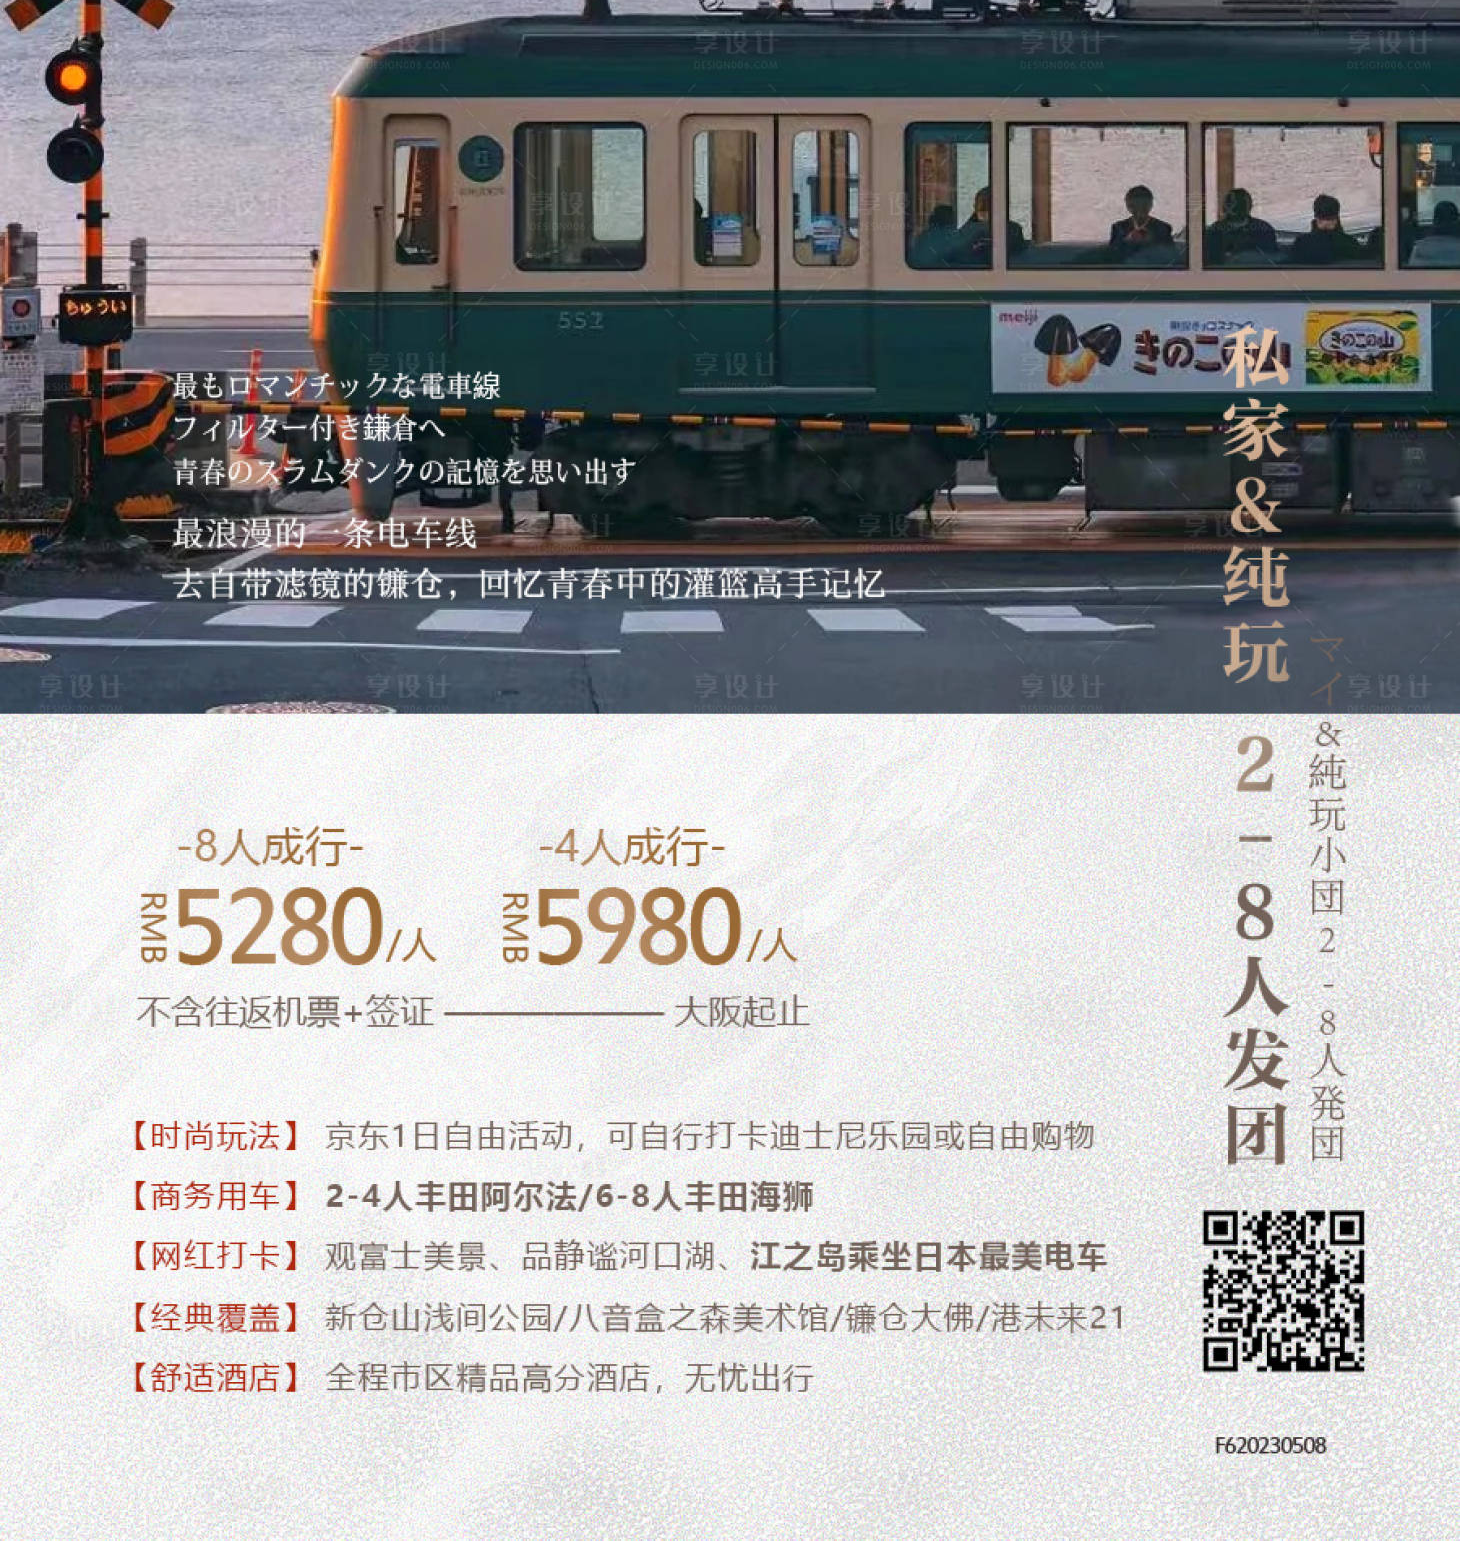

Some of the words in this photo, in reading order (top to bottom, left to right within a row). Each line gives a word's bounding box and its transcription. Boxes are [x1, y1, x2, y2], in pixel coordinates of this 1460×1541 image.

[998, 307, 1038, 326] meiji
[173, 369, 501, 400] 最もロマンチックな電車線
[174, 413, 446, 442] フィルター付き鎌倉へ
[173, 458, 635, 486] 青春のスラムダンクの記憶を思い出す
[1222, 325, 1290, 683] 私家&纯玩
[173, 516, 477, 549] 最浪漫的一条电车线
[140, 893, 168, 964] RMB
[502, 893, 530, 964] RMB
[137, 994, 434, 1029] 不含往返机票+签证
[675, 994, 811, 1029] 大阪起止
[1215, 1435, 1327, 1454] F620230508
